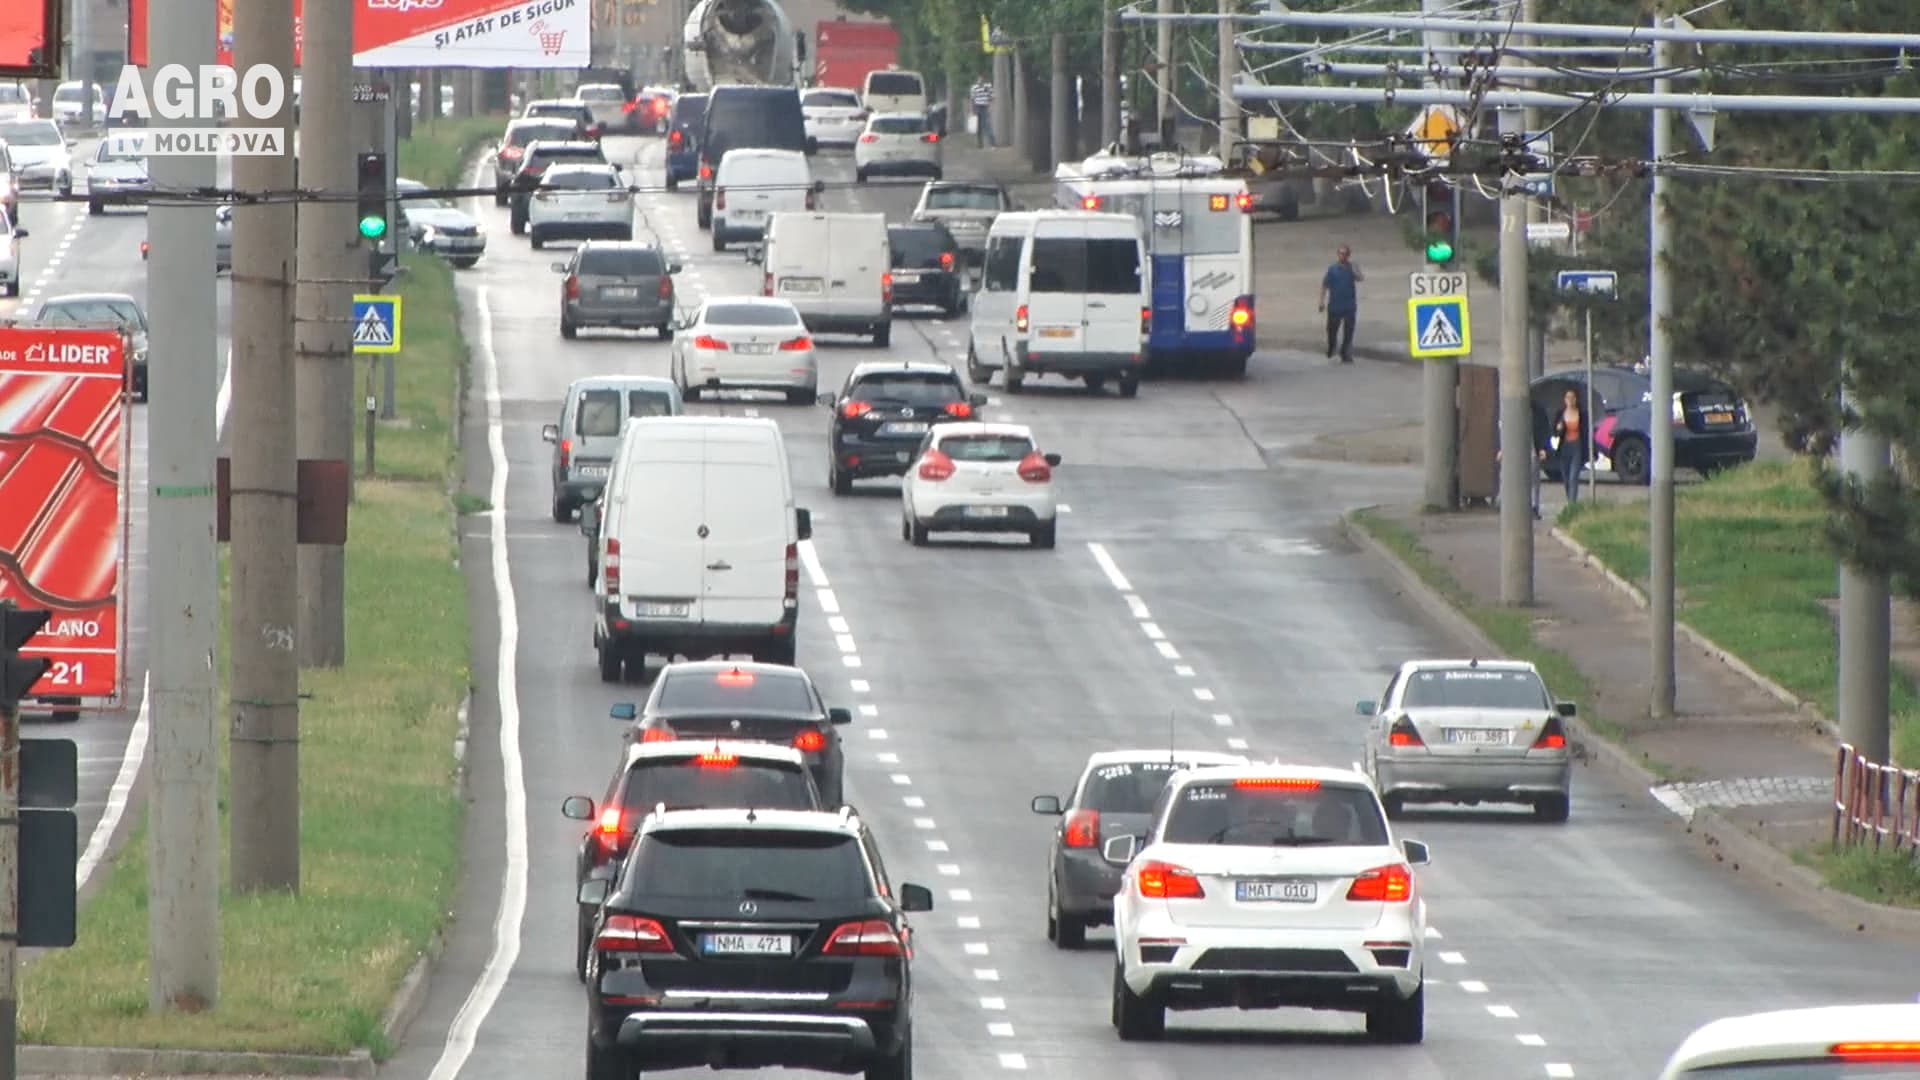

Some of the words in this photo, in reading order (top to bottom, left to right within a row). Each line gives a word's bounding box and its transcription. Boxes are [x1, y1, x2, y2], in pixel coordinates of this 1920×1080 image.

[455, 18, 495, 41] ATÂT
[500, 11, 521, 28] DE
[1415, 275, 1463, 295] STOP
[48, 343, 110, 364] LIDER
[1248, 884, 1273, 897] MAT
[1284, 884, 1309, 897] 010
[717, 935, 744, 951] NMA
[758, 936, 782, 952] 471
